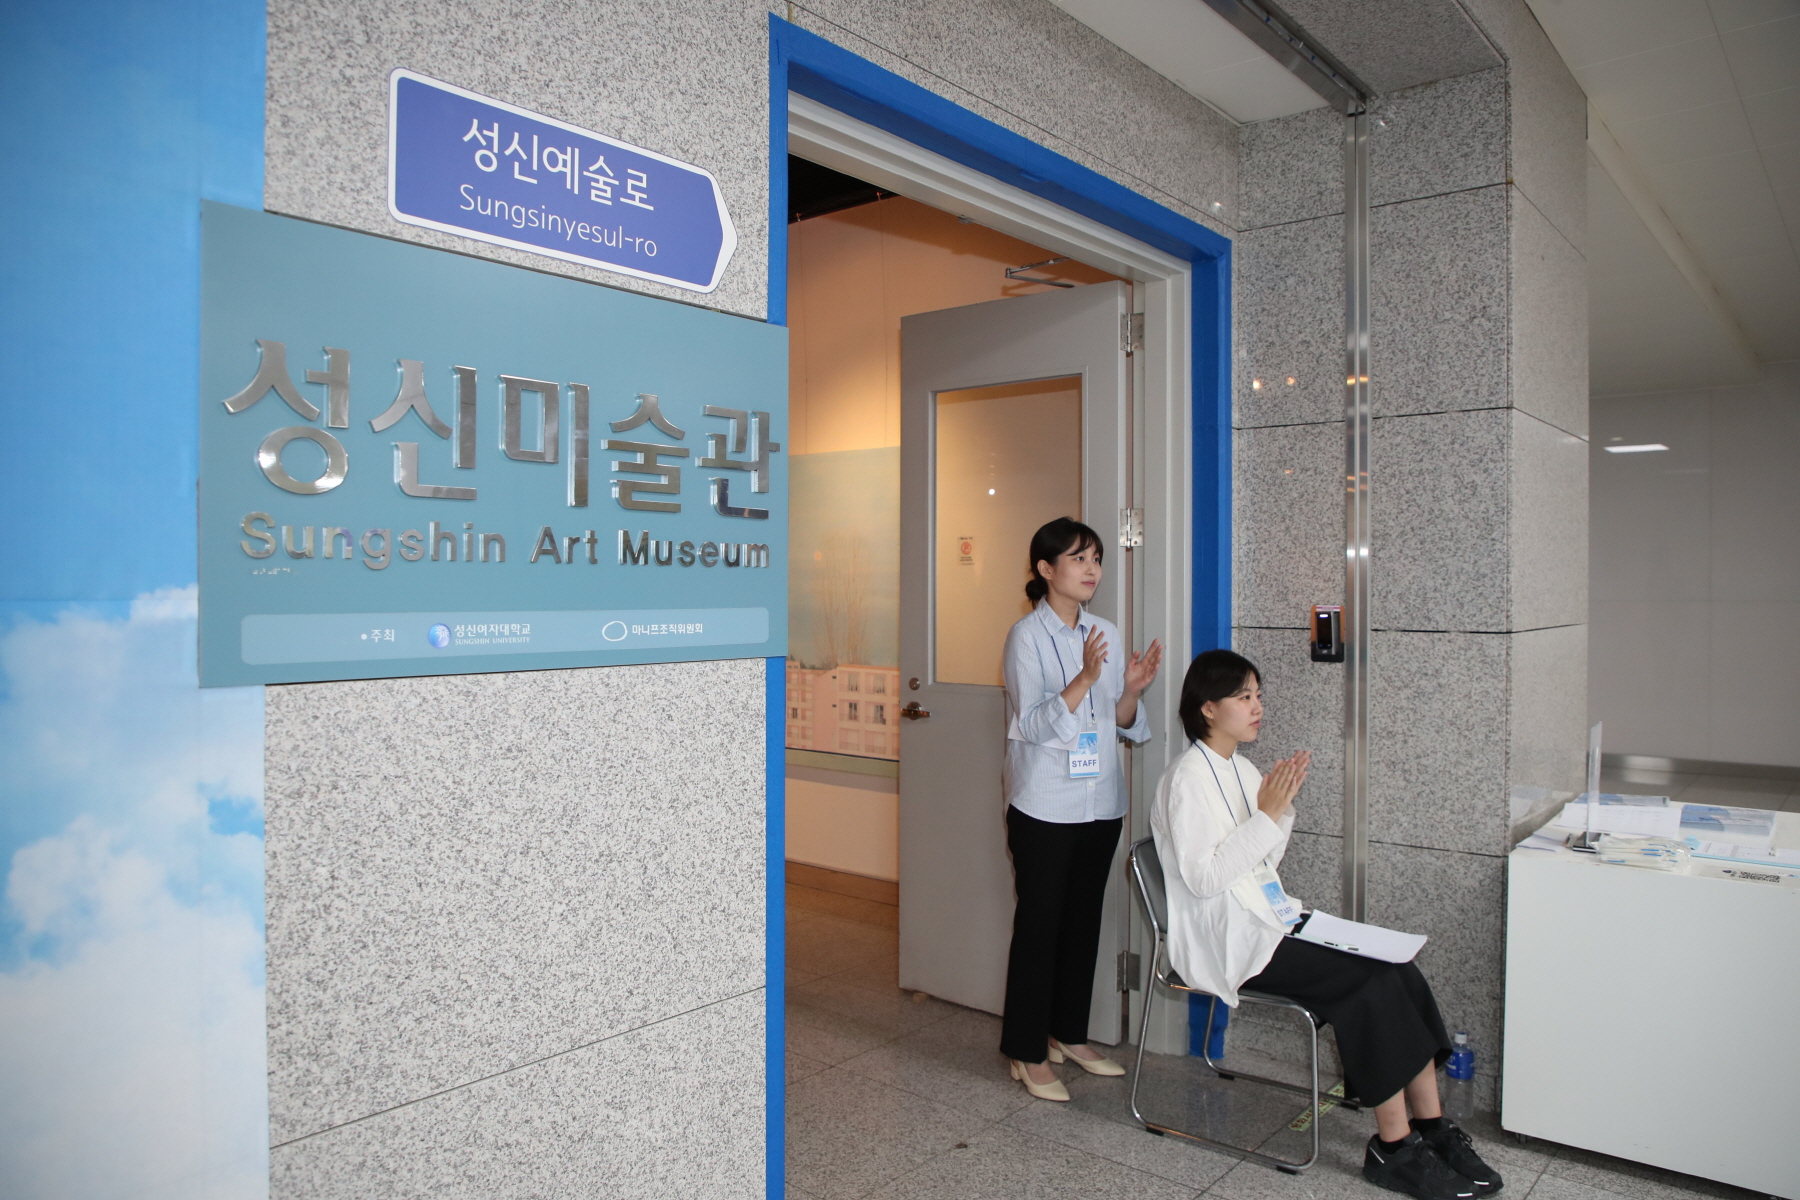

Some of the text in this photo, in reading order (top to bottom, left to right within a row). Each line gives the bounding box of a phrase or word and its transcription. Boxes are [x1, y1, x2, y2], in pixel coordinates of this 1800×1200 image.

[462, 118, 655, 211] 성신예술로
[459, 183, 658, 257] Sungsinyesul-ro
[221, 338, 781, 519] 성신미술관
[240, 511, 770, 570] Sungshin Art Museum
[370, 628, 395, 643] 주최
[454, 623, 531, 638] 성신여자대학교
[632, 623, 703, 635] 마니프조직위원회
[455, 636, 531, 645] SUNGSHIN UNIVERSITY
[1071, 759, 1097, 768] STAFF
